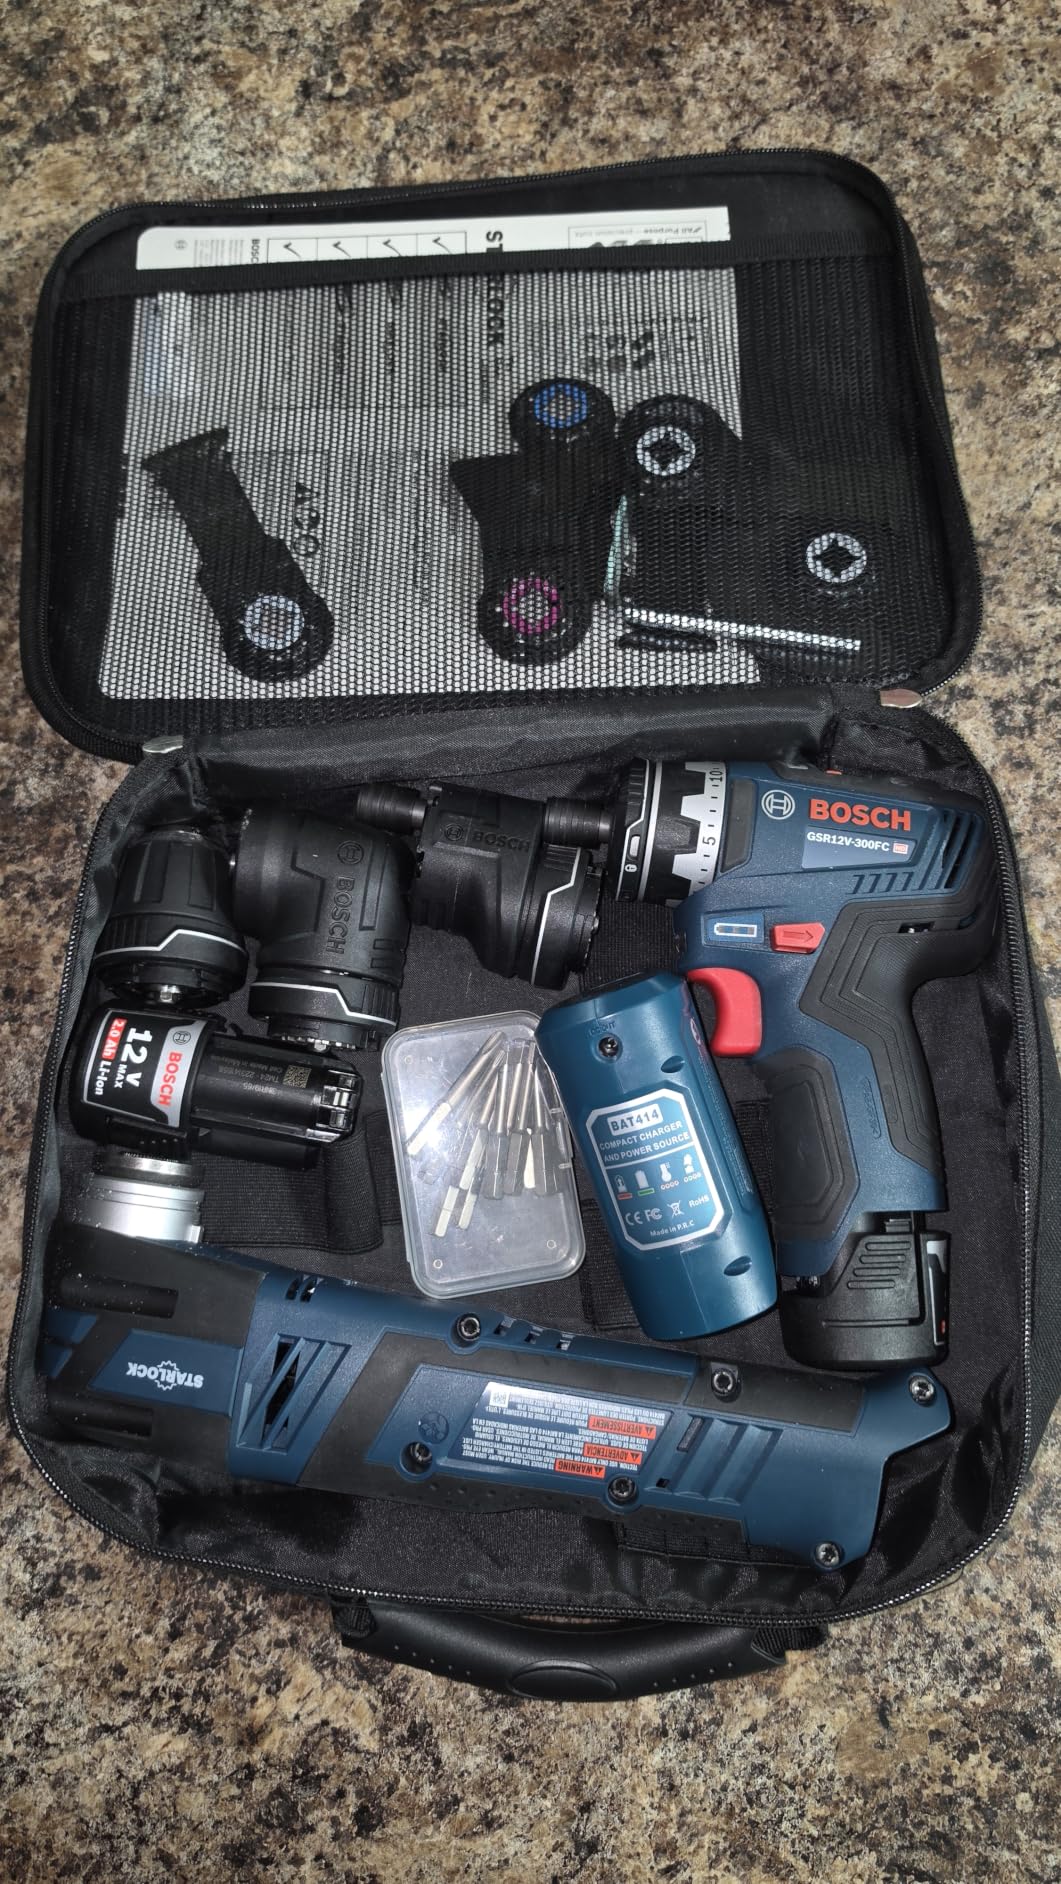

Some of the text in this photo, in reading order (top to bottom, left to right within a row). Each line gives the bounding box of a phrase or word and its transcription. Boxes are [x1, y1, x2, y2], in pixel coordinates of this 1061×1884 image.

[251, 239, 260, 264] BOSC
[709, 770, 723, 782] 10
[809, 798, 911, 831] BOSCH
[702, 837, 716, 846] 5
[807, 832, 890, 852] GSR12V-300FC
[326, 876, 355, 954] BOSCH
[94, 1017, 125, 1096] 2.0 Ah Li-Ion
[120, 1026, 153, 1087] 12 V
[113, 1063, 127, 1089] MAX
[157, 1050, 182, 1107] BOSCH
[611, 1109, 659, 1131] BAT414
[599, 1120, 683, 1150] COMPACT CHARGER
[604, 1132, 690, 1163] AND POWER SOURCE
[689, 1195, 710, 1208] RoHS
[650, 1229, 668, 1237] Made
[126, 1362, 203, 1388] STARLOCK
[592, 1417, 642, 1435] AVERTISSEMENT
[586, 1445, 627, 1461] ADVERTENCIA
[558, 1460, 592, 1474] WARNING
